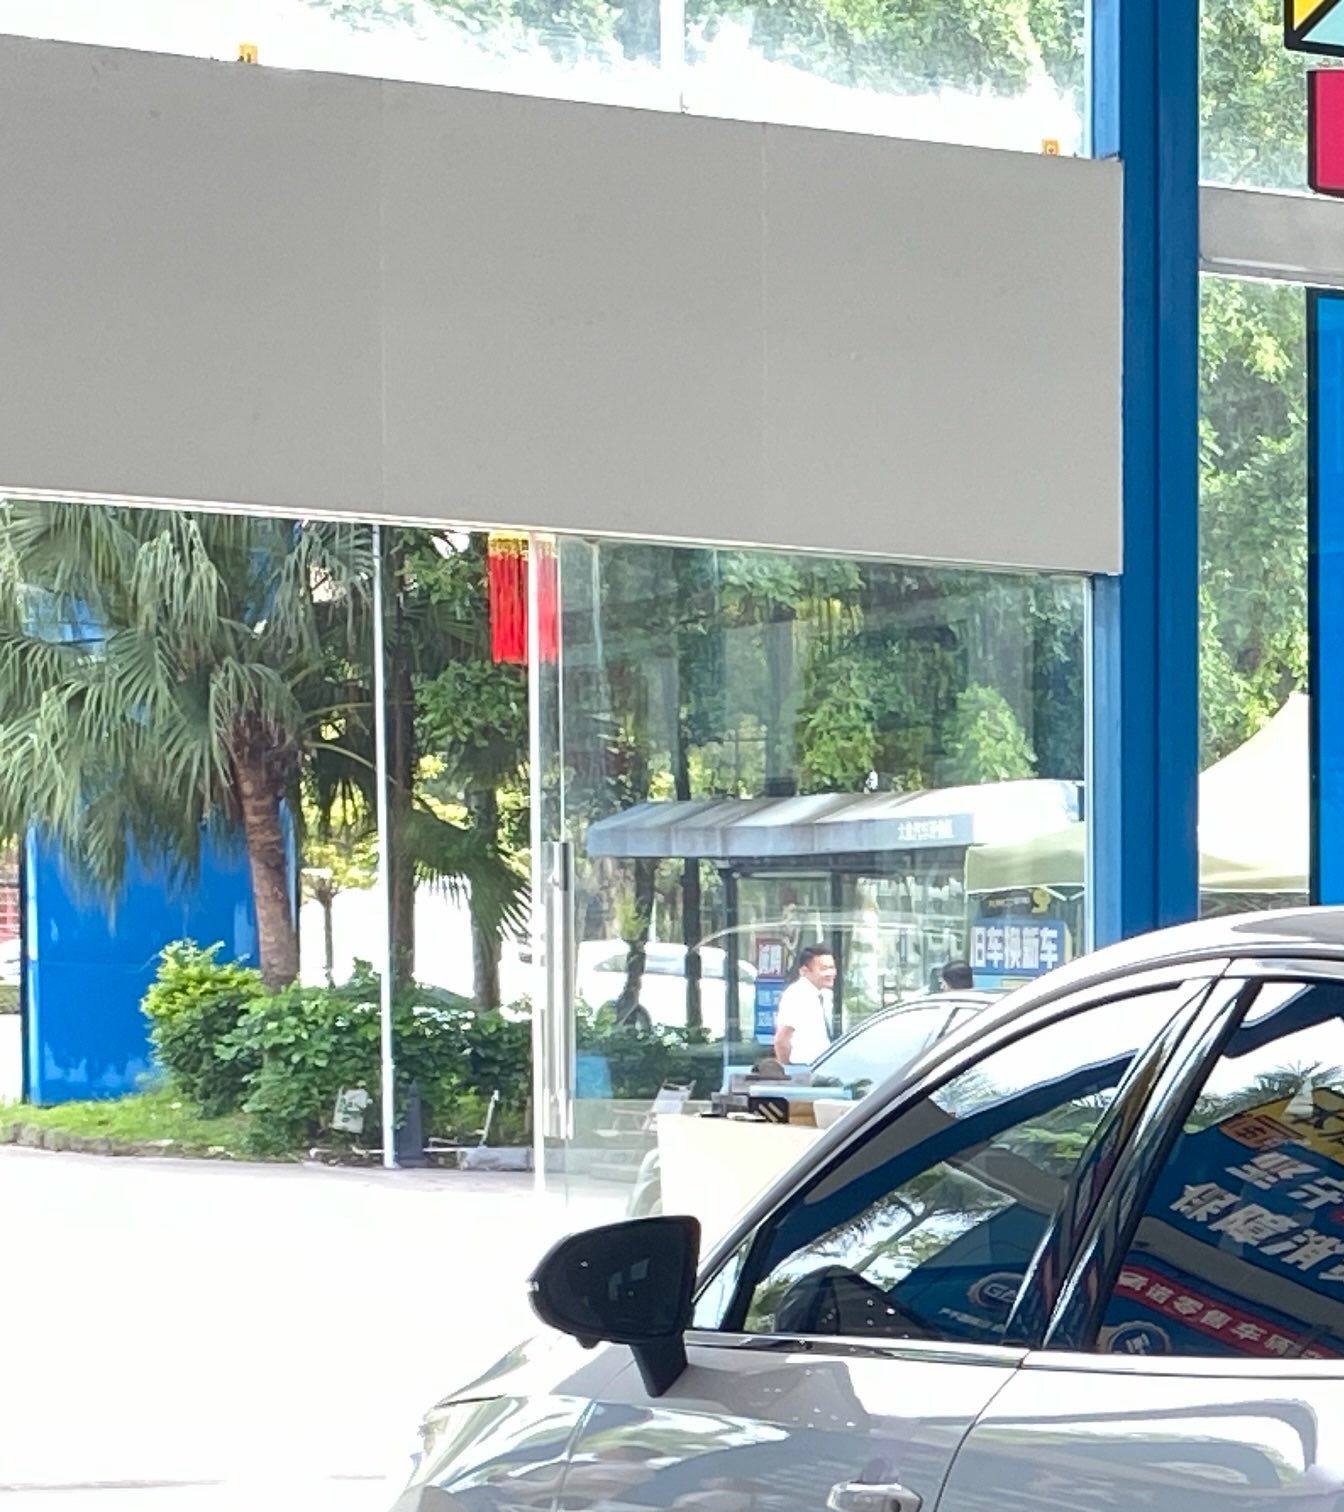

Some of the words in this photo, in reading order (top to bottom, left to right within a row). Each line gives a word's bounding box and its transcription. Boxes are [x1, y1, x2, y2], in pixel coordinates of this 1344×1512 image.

[970, 926, 1059, 969] 旧车换新车
